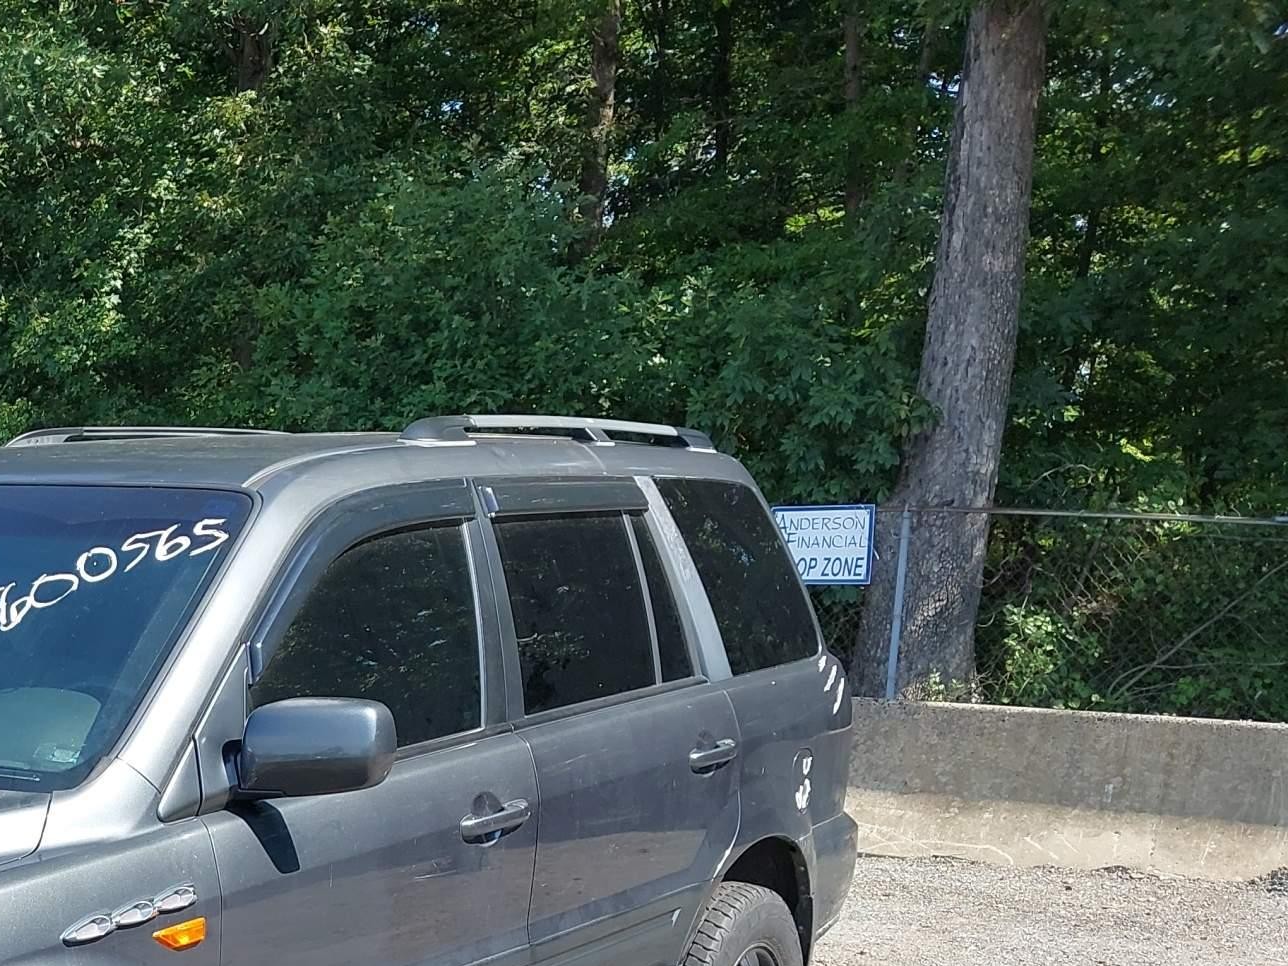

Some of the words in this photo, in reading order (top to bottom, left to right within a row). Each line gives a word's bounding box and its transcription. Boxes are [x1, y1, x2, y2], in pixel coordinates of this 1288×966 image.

[778, 513, 866, 534] ANDERSON
[787, 532, 867, 549] FINANCIAL
[821, 557, 865, 577] ZONE
